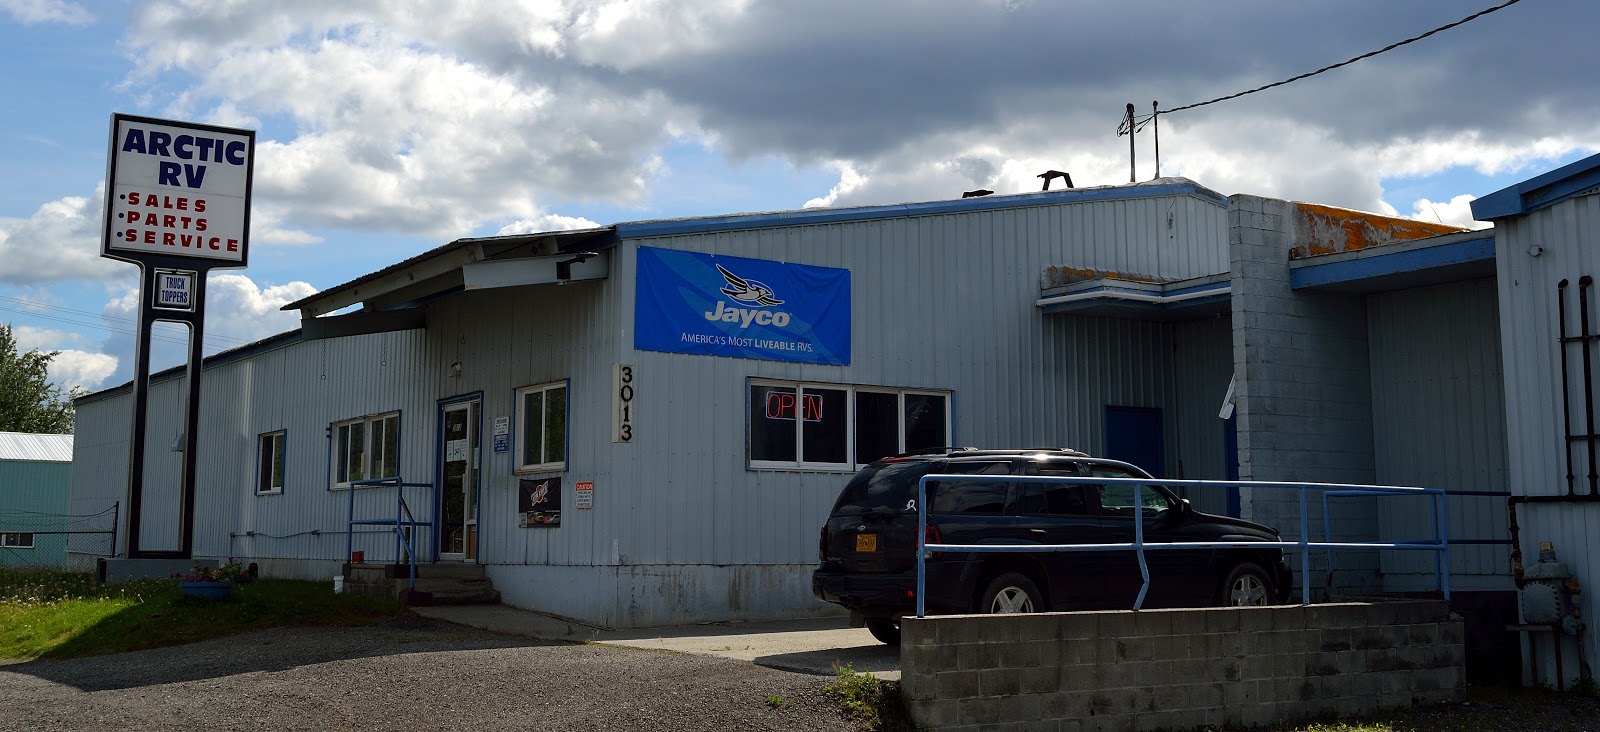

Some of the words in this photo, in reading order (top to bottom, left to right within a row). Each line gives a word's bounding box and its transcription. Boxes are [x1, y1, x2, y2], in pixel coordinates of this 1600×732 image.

[122, 128, 246, 166] ARCTIC
[158, 161, 207, 189] RV
[128, 192, 206, 213] SALES
[126, 211, 207, 231] PARTS
[125, 229, 238, 252] SERVICE
[166, 277, 186, 290] TRUCK
[161, 290, 188, 304] TOPPERS
[704, 301, 791, 328] Jayco
[680, 332, 726, 346] AMERICA'S
[728, 336, 753, 347] MOST
[754, 338, 796, 351] LIVEABLE
[620, 366, 634, 442] 3013
